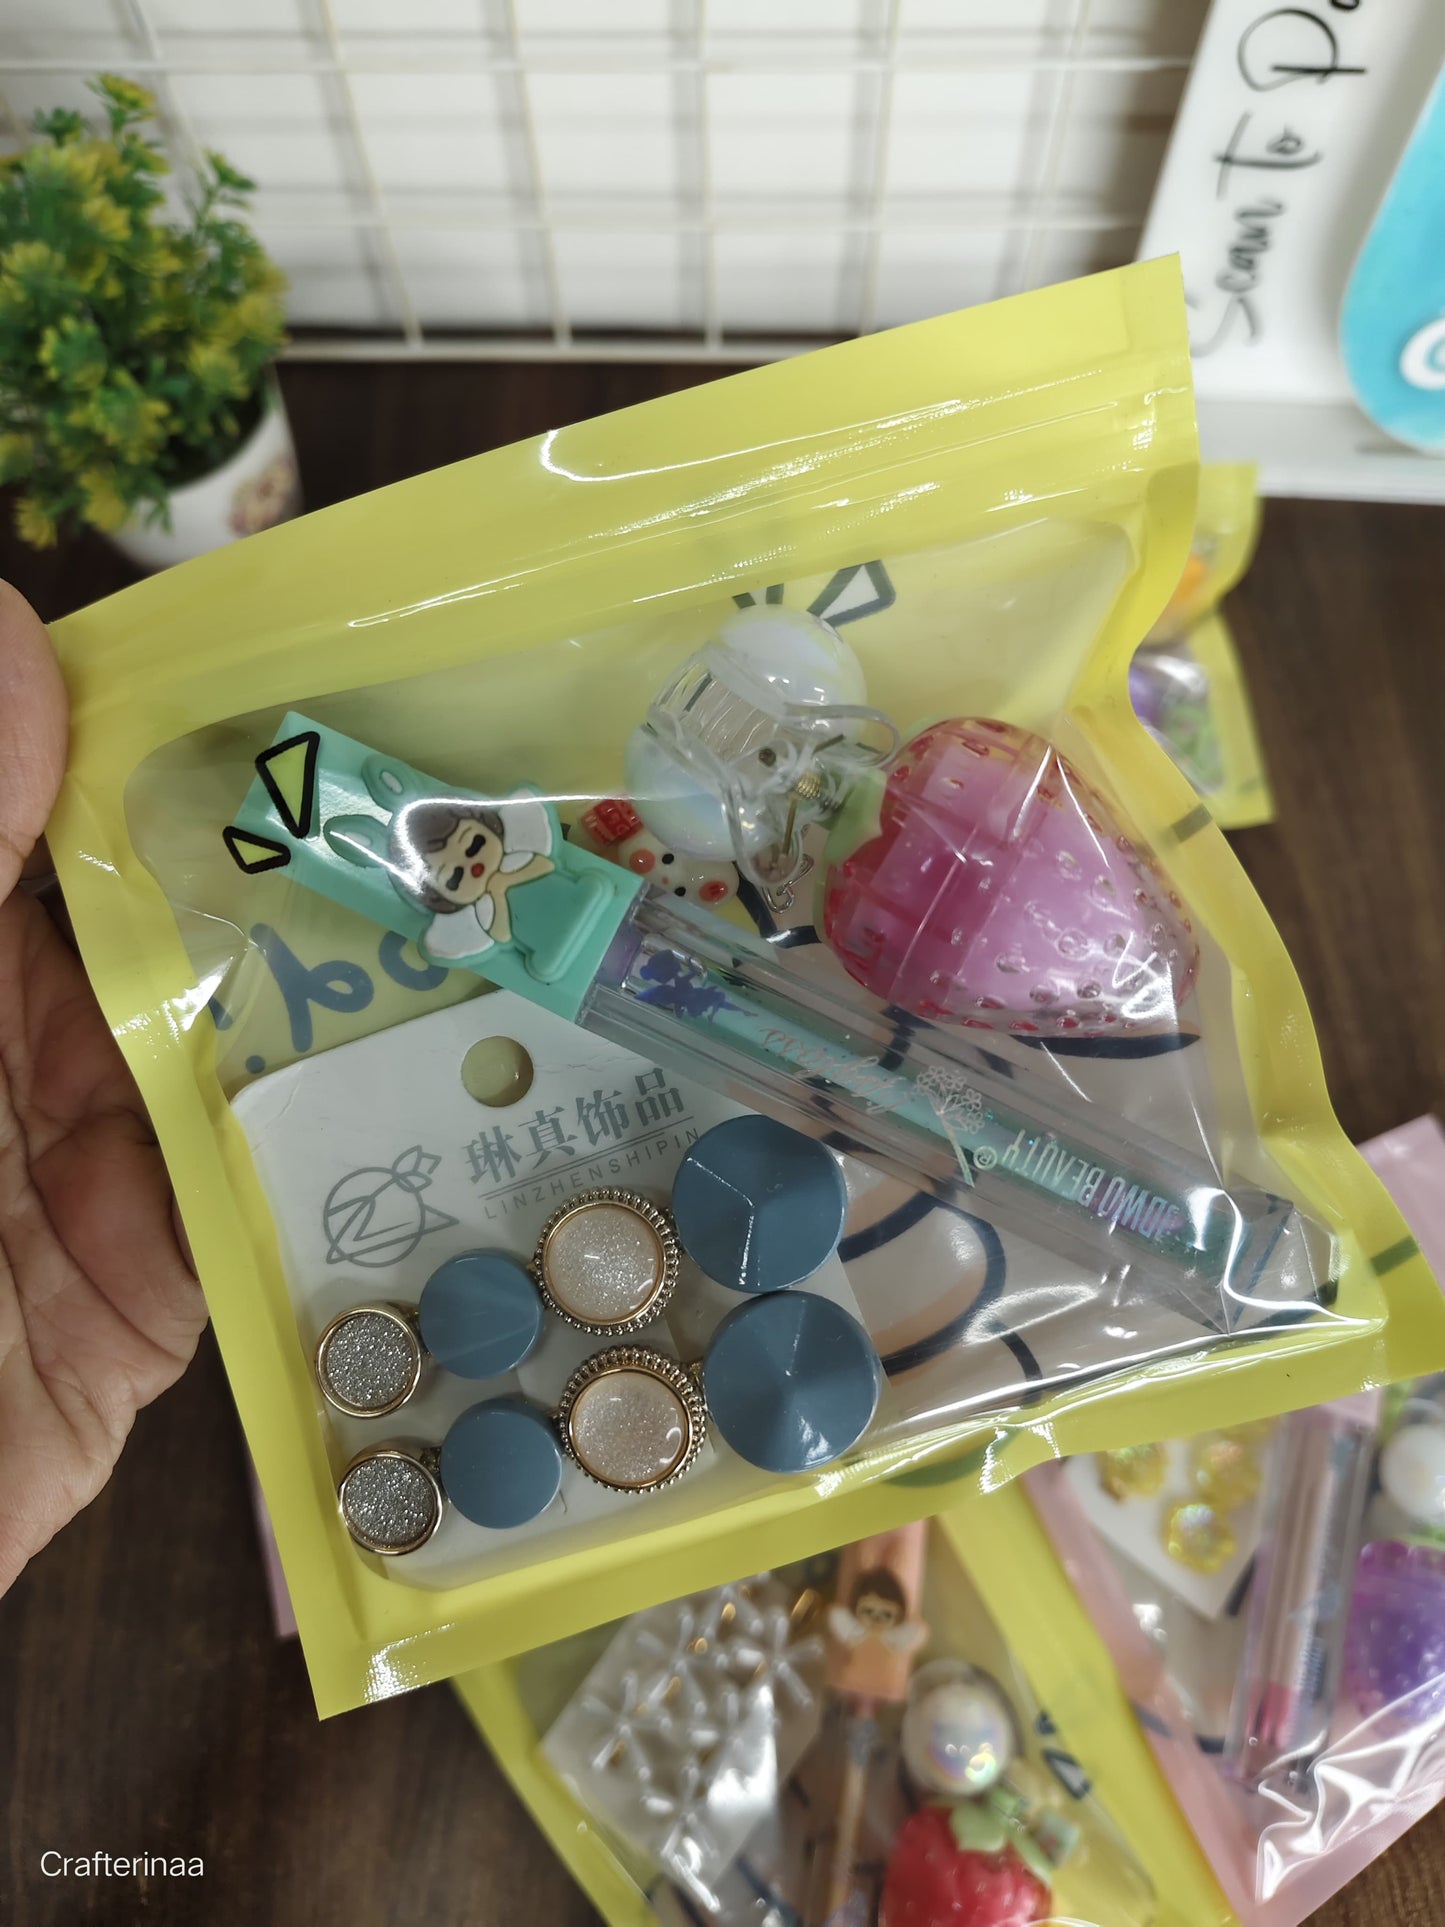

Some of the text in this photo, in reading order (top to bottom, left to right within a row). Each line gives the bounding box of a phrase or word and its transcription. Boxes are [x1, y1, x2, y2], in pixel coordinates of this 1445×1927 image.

[1185, 200, 1284, 357] Scan
[463, 1067, 685, 1184] 琳真饰品
[484, 1127, 700, 1220] LINZHENSHIPIN
